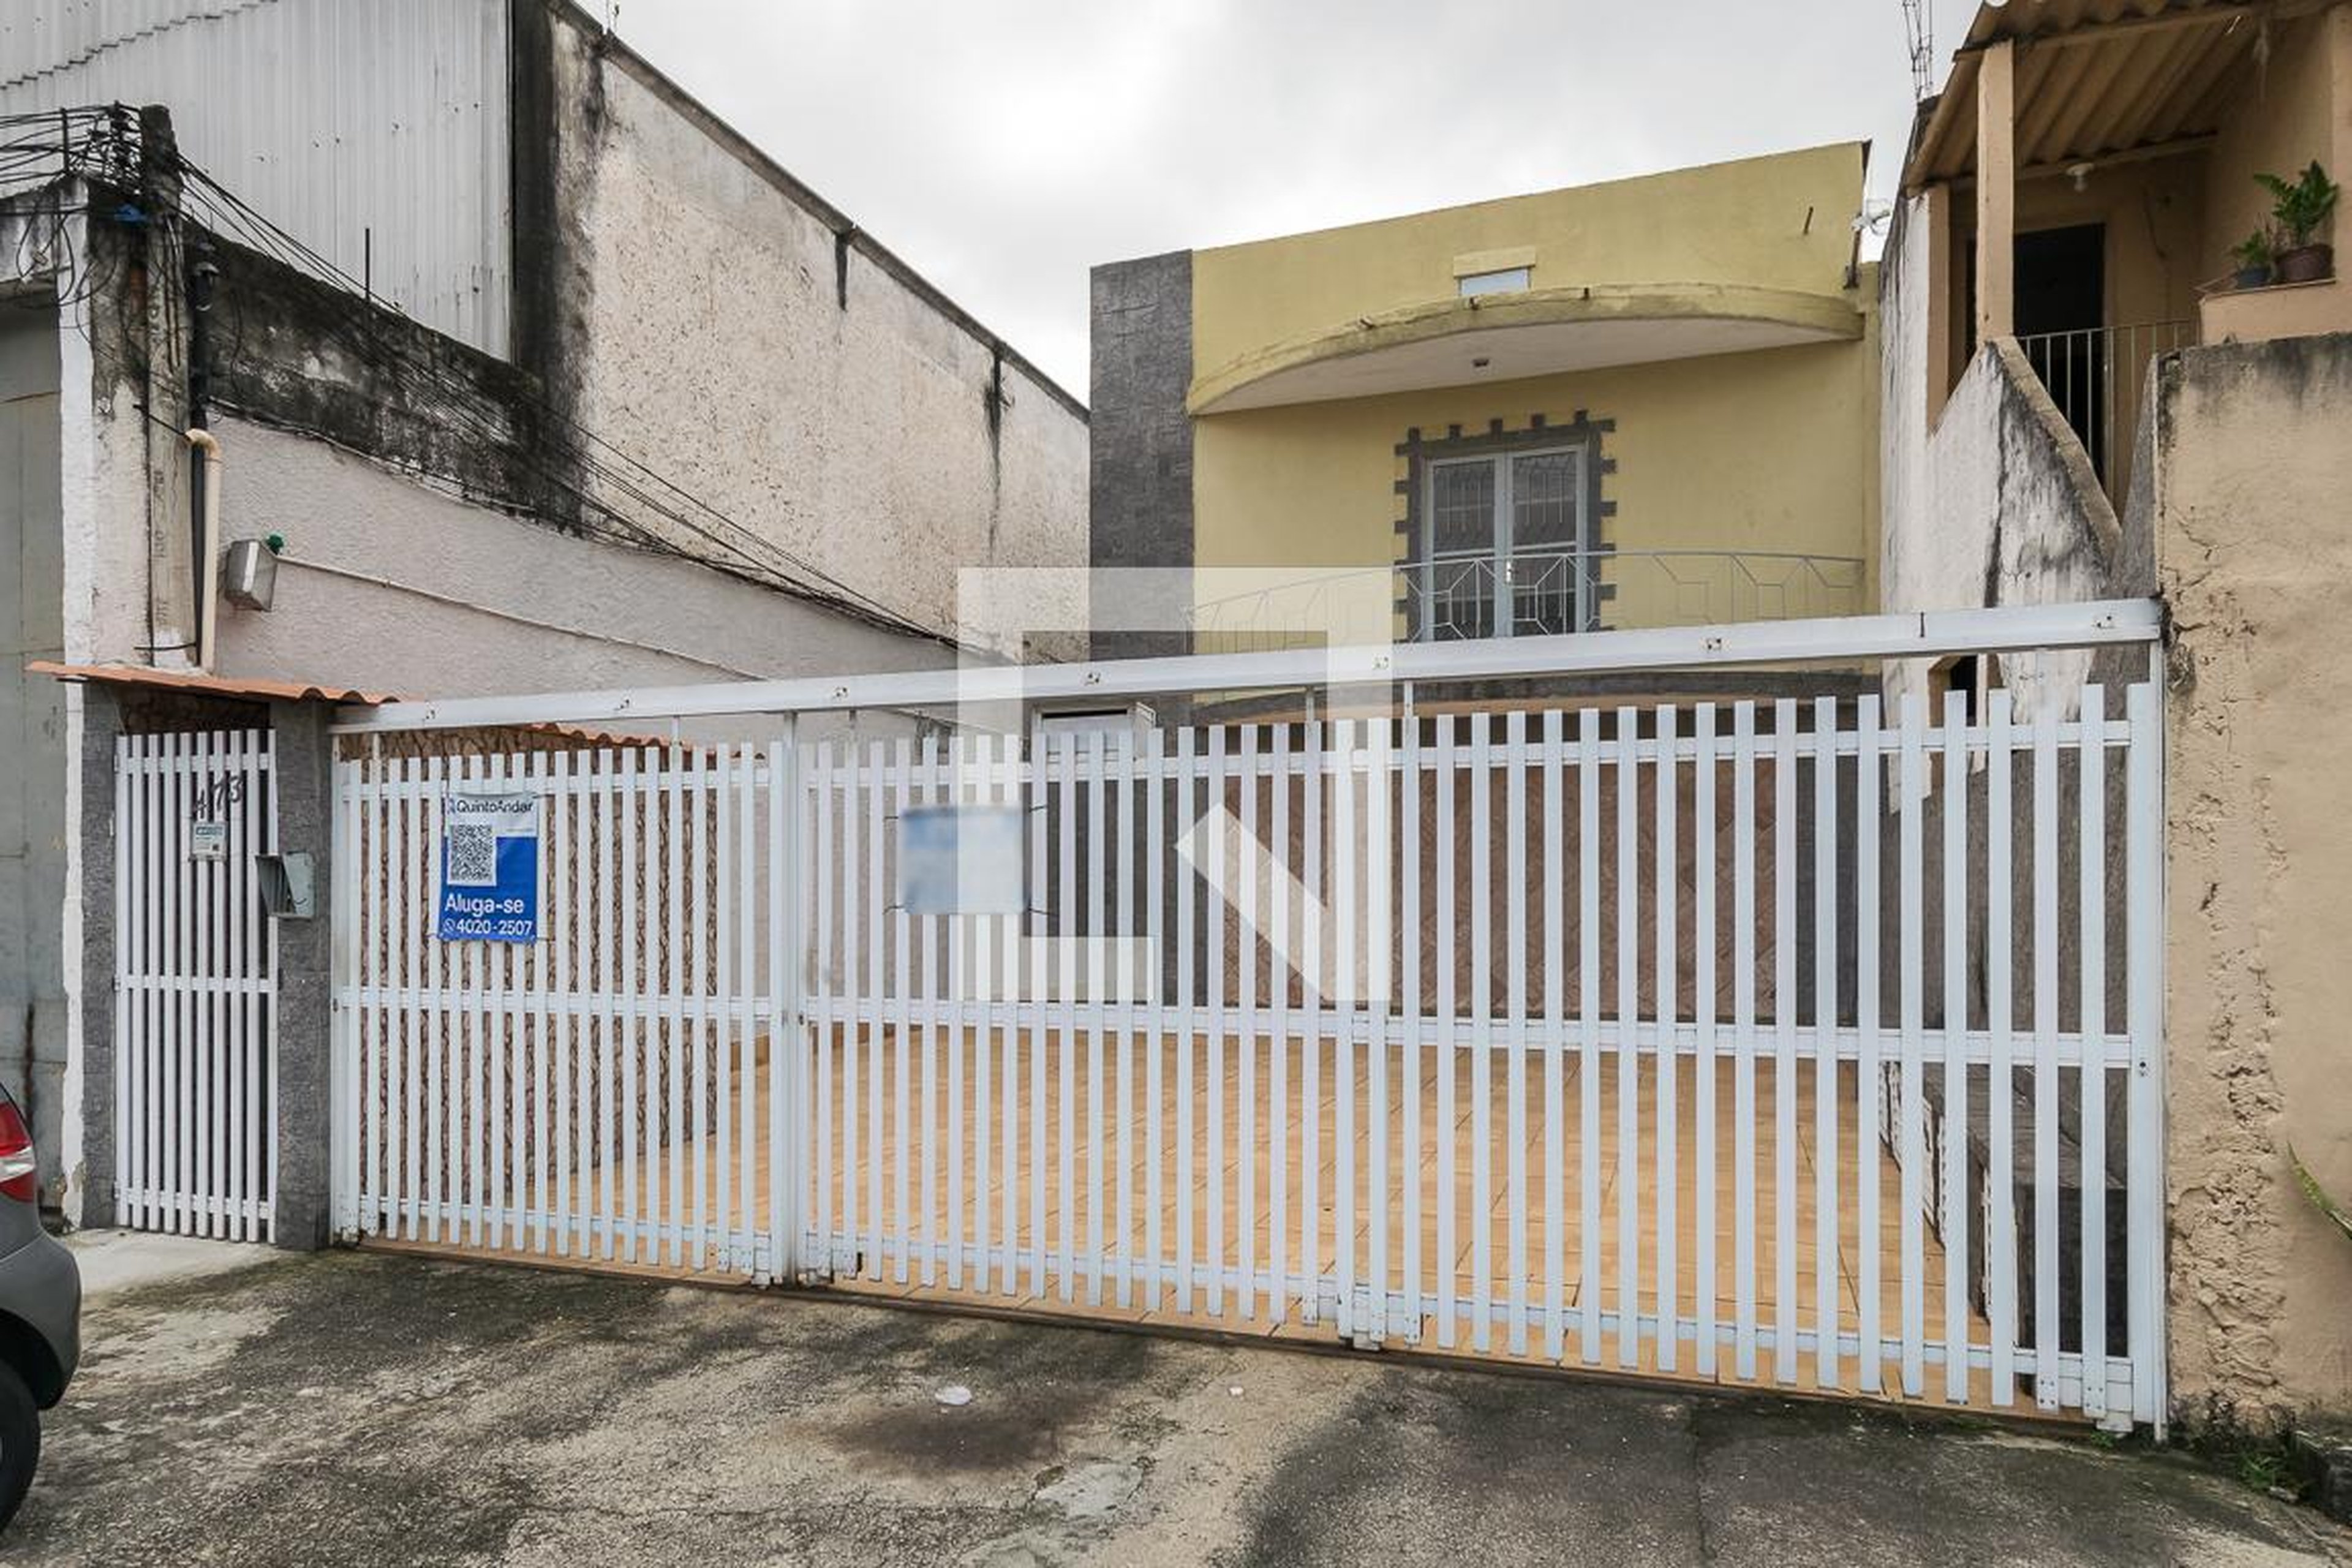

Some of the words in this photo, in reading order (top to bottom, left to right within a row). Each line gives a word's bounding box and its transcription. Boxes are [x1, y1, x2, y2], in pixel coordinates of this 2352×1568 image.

[457, 799, 533, 813] QuintoAndar
[445, 893, 524, 917] Aluga-se
[456, 919, 532, 936] 4020-2507
